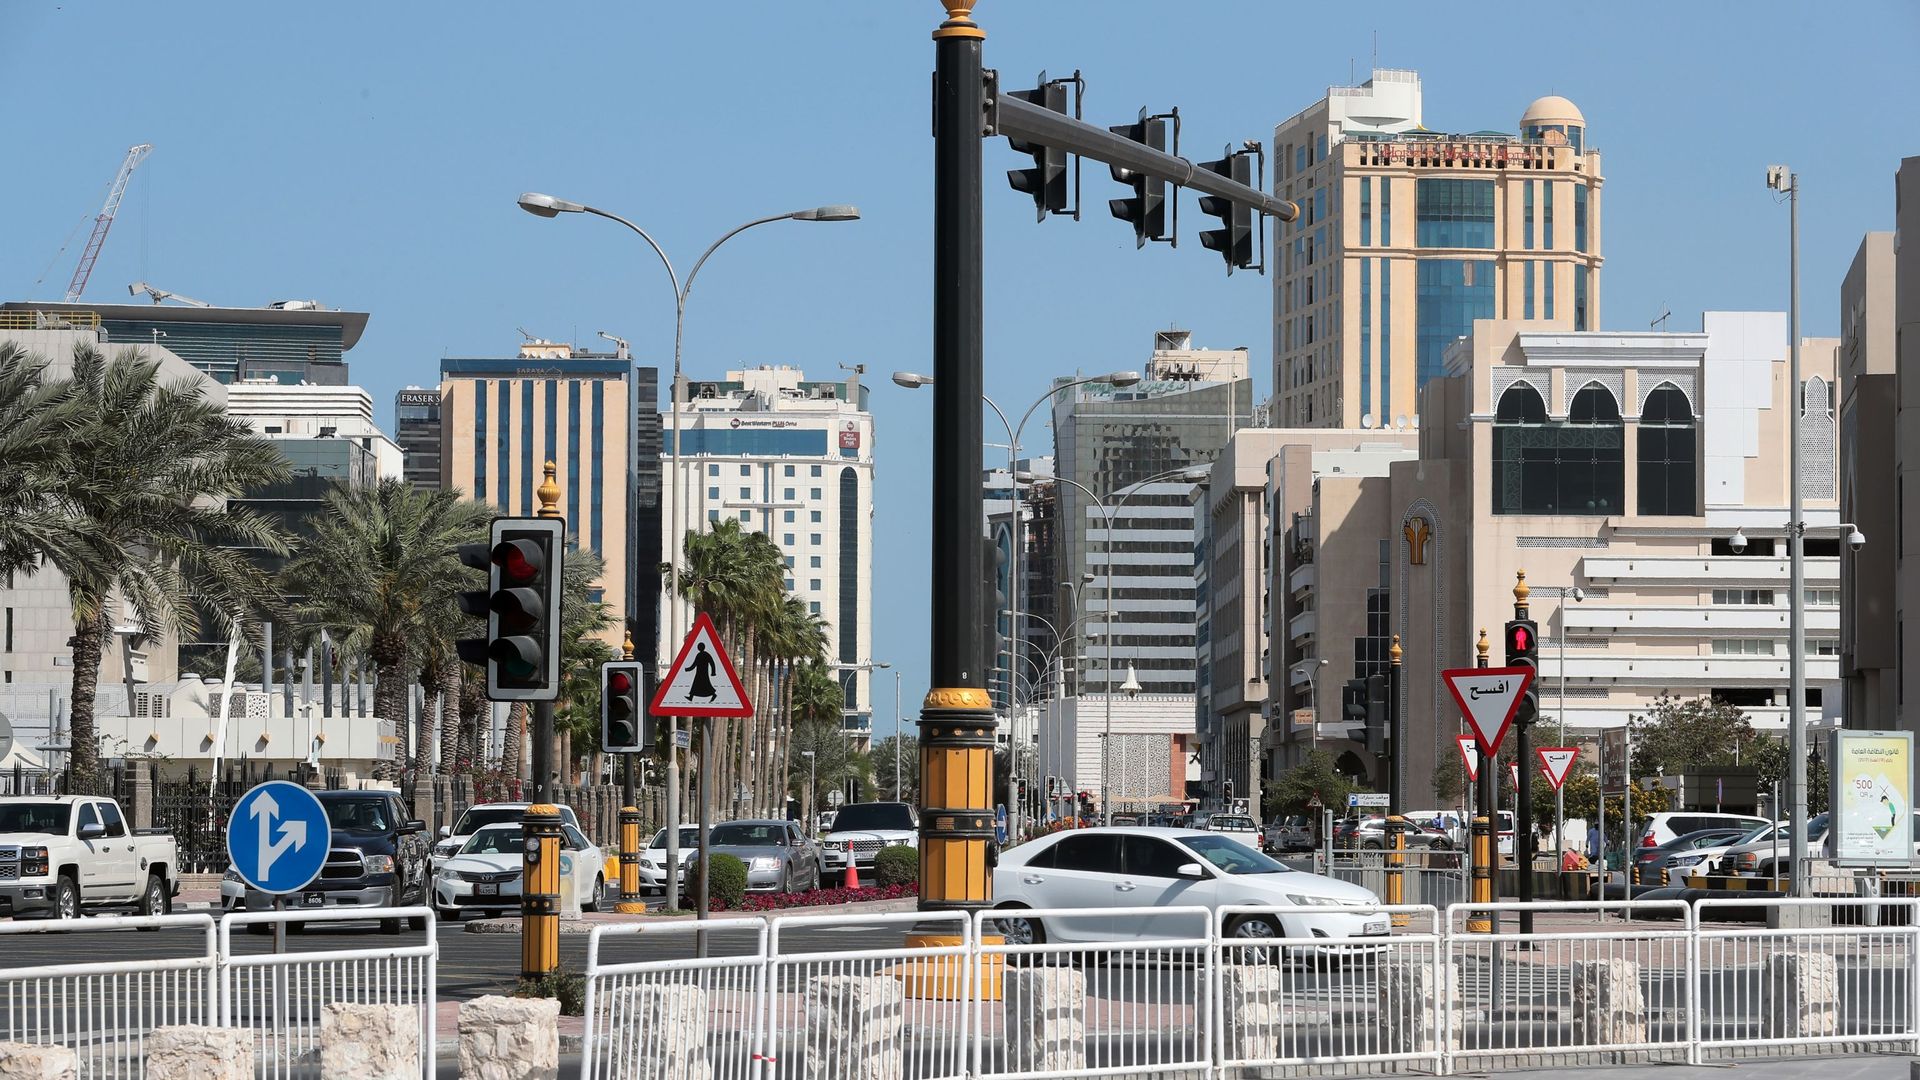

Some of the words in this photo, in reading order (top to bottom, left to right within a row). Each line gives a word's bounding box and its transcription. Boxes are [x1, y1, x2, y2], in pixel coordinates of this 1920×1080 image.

[401, 394, 434, 402] FRASER
[1469, 680, 1509, 700] افسح
[1549, 754, 1568, 763] افسح
[537, 784, 543, 793] 9
[1855, 780, 1873, 789] 500
